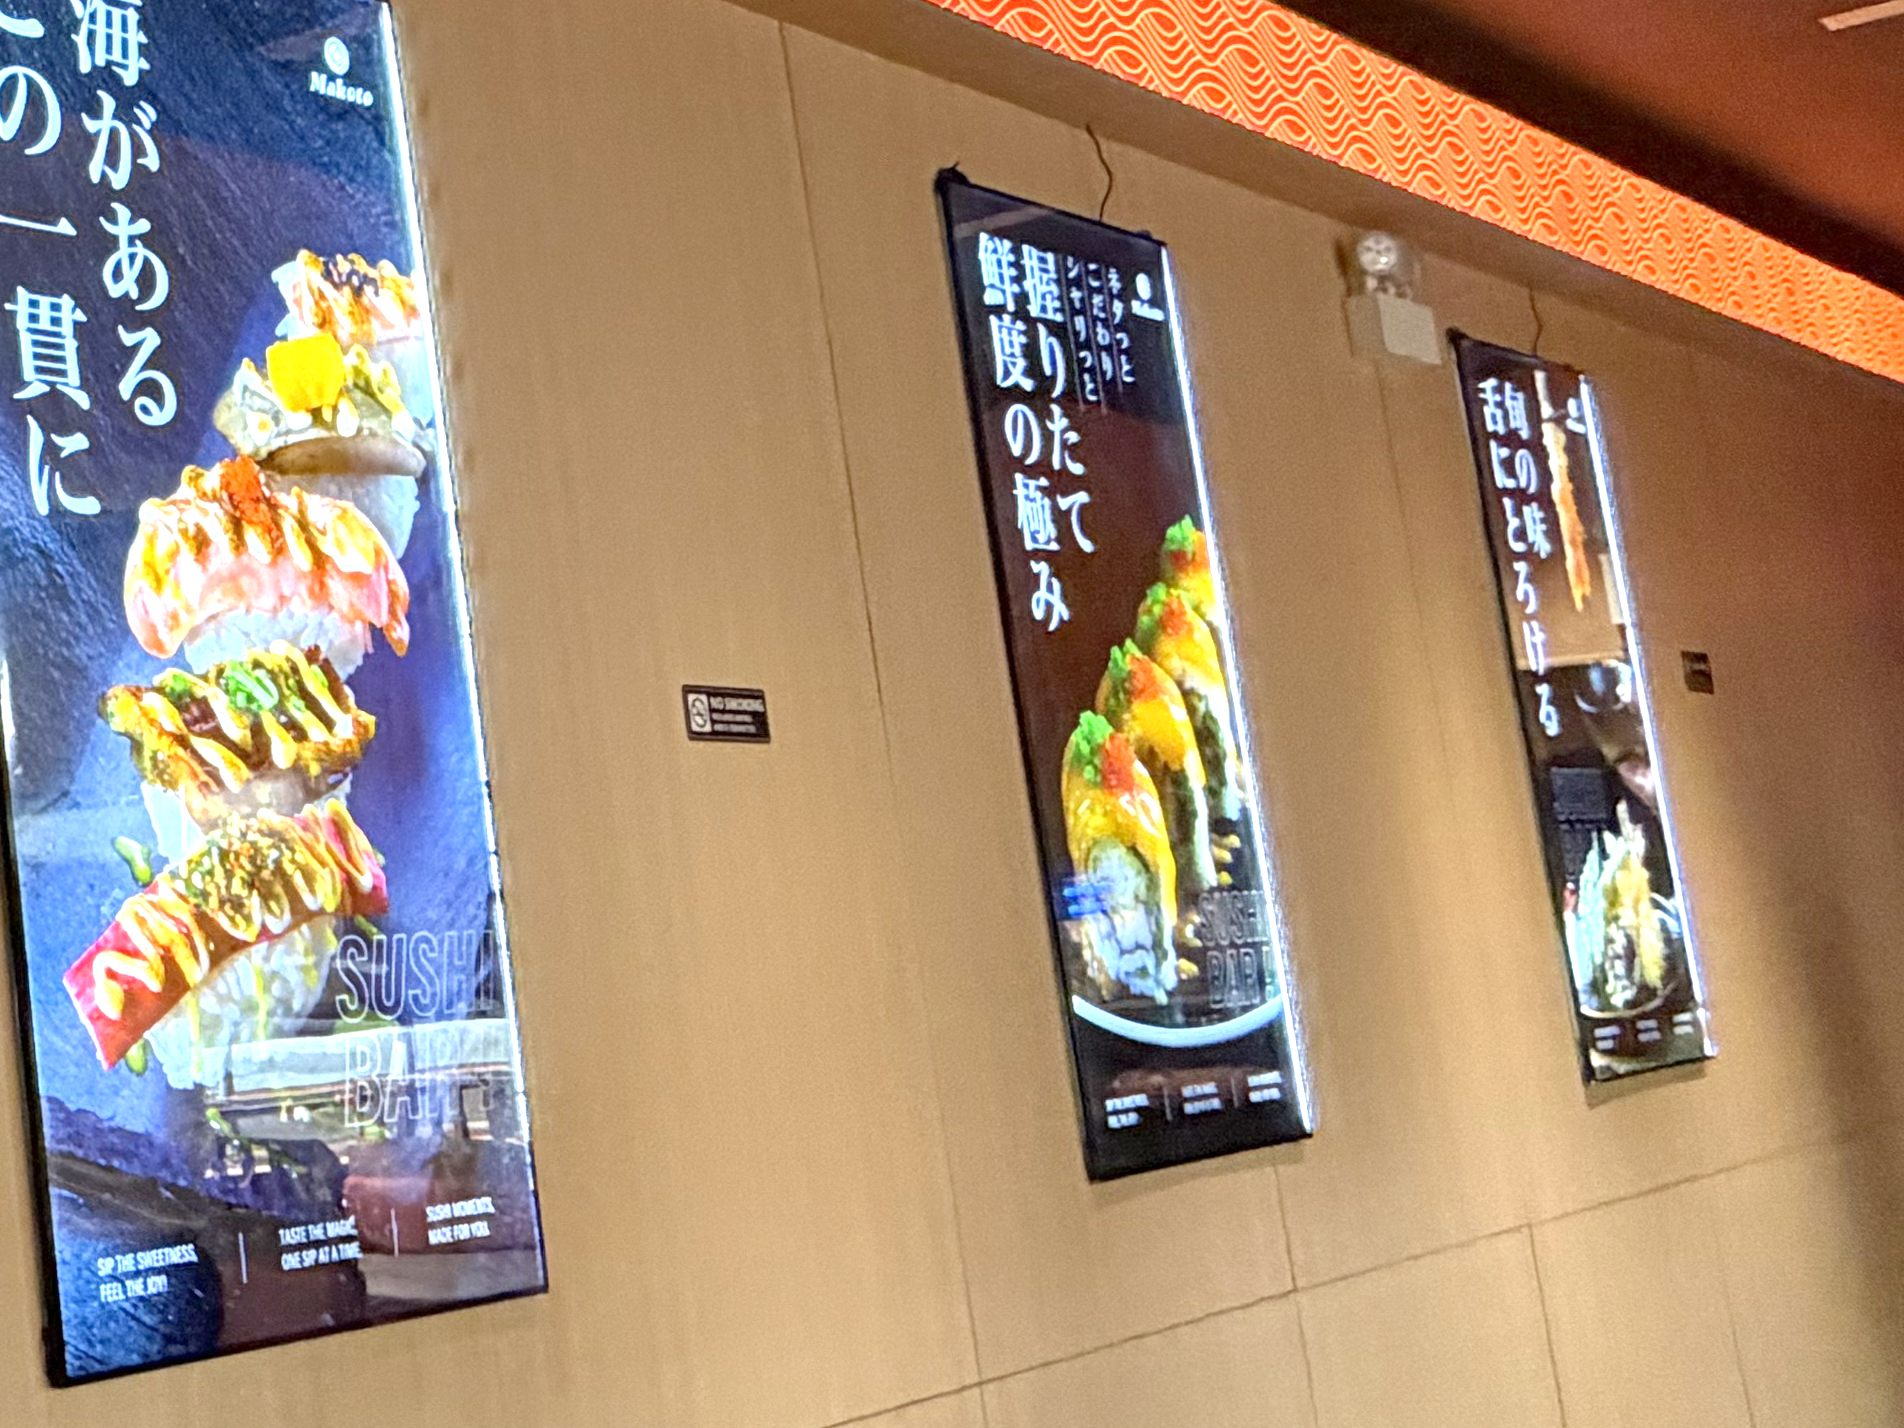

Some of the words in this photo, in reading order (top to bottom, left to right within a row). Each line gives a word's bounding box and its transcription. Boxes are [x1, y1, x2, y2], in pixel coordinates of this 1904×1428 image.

[309, 71, 373, 106] Makoto
[979, 231, 1071, 632] 鮮度の極み
[1021, 243, 1096, 554] 握りたて
[335, 930, 493, 1022] SUSHI
